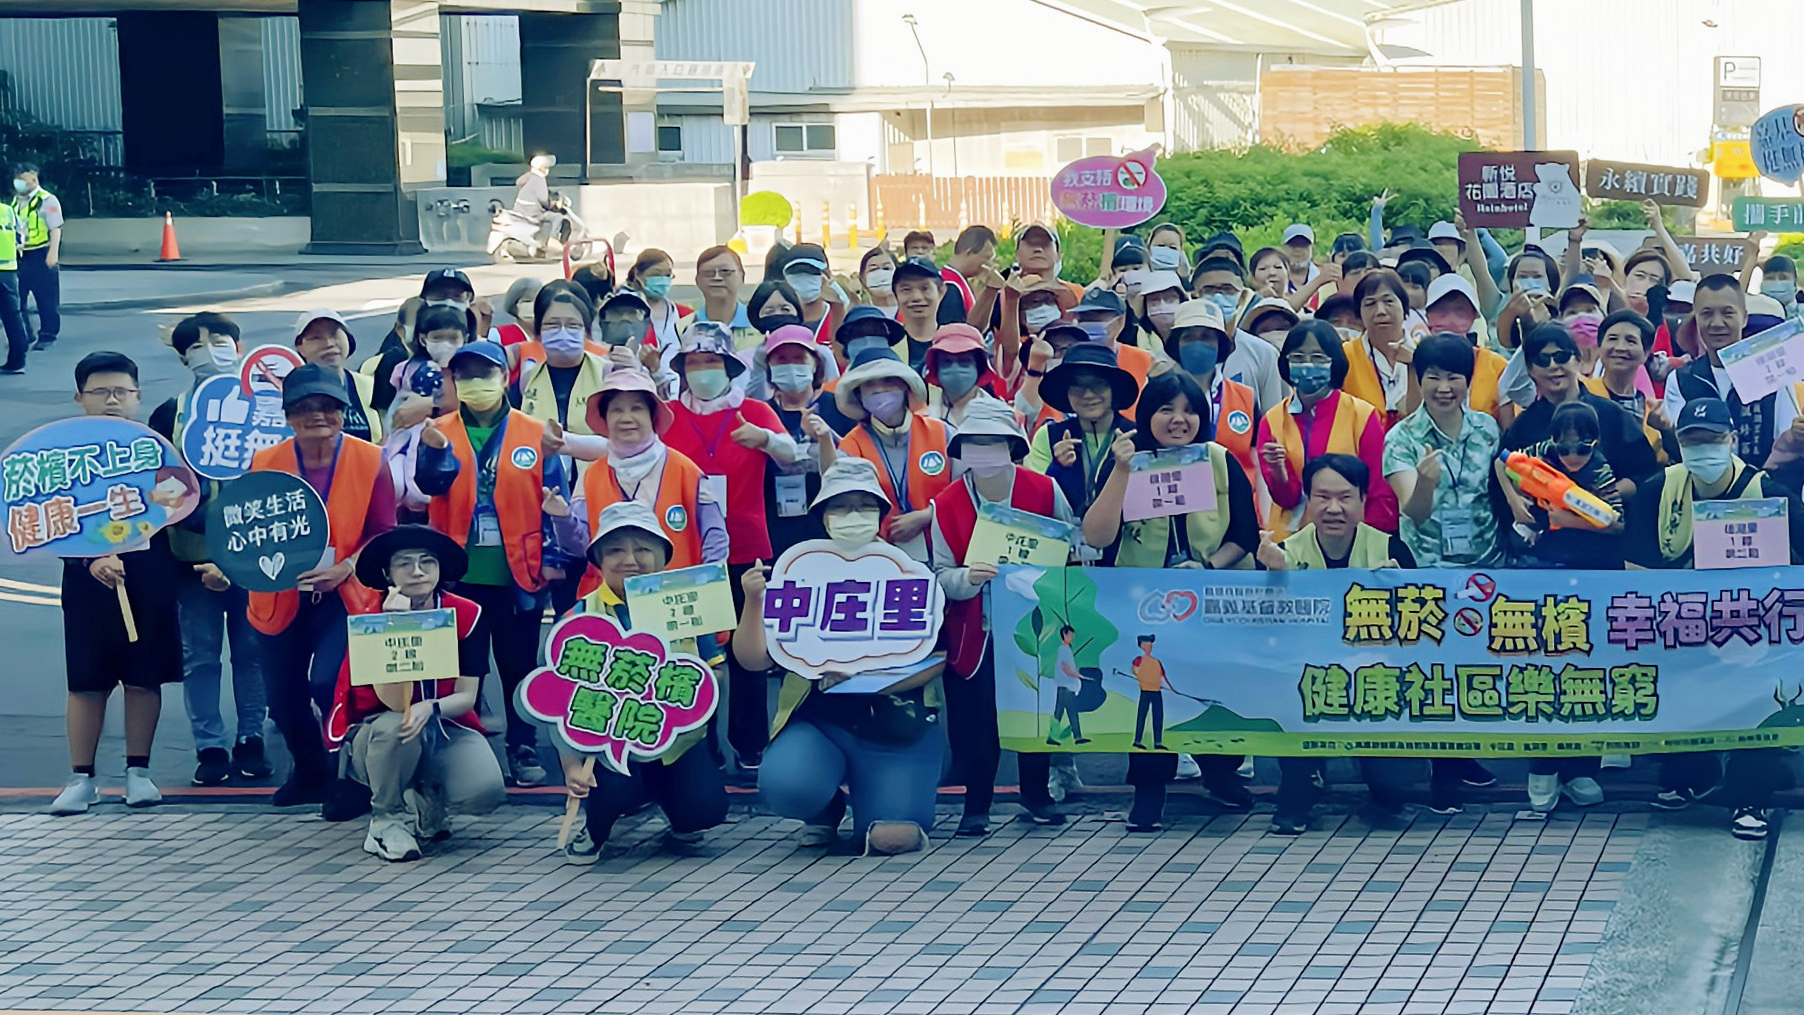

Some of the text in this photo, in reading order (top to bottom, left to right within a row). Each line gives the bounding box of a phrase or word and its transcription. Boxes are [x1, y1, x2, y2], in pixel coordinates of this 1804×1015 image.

[1724, 62, 1736, 80] P
[3, 437, 163, 503] 菸檳不上身
[8, 484, 146, 553] 健康一生
[223, 488, 307, 529] 微笑生活
[227, 515, 311, 552] 心中有光
[763, 579, 930, 633] 中庄里
[1342, 582, 1449, 646] 無菸
[1487, 592, 1595, 656] 無檳
[556, 636, 703, 709] 無菸檳
[1298, 661, 1659, 723] 健康社區樂無窮
[567, 685, 666, 746] 醫院
